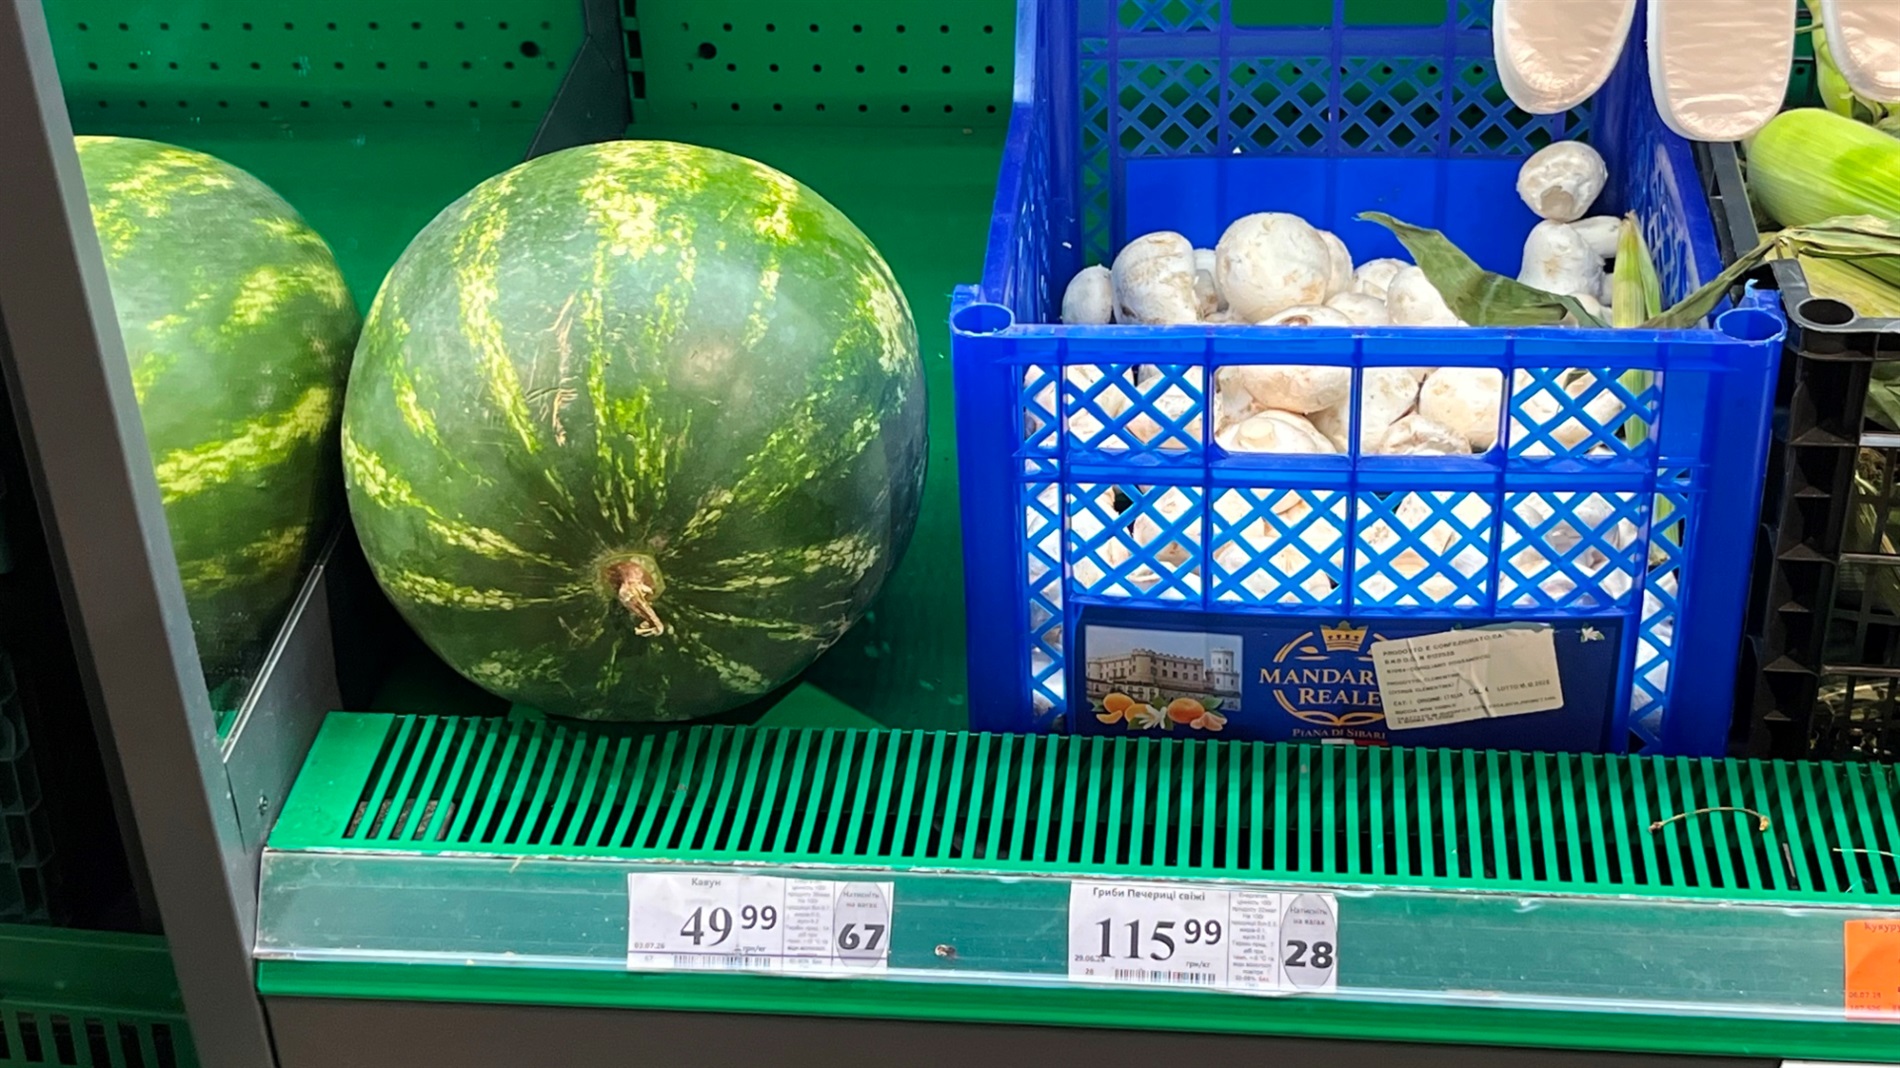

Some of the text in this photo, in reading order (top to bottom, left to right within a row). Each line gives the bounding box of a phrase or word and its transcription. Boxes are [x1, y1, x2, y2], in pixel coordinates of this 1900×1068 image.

[1258, 668, 1377, 685] MANDAR
[1298, 687, 1382, 706] REALE
[1292, 728, 1329, 737] PIANA
[1345, 728, 1386, 740] SIBARI
[691, 878, 722, 888] Кавун
[1093, 887, 1205, 901] Гриби Печериці свіжі
[680, 905, 778, 947] 49 99
[838, 923, 885, 951] 67
[1096, 917, 1222, 962] 115 99
[1285, 940, 1334, 970] 28
